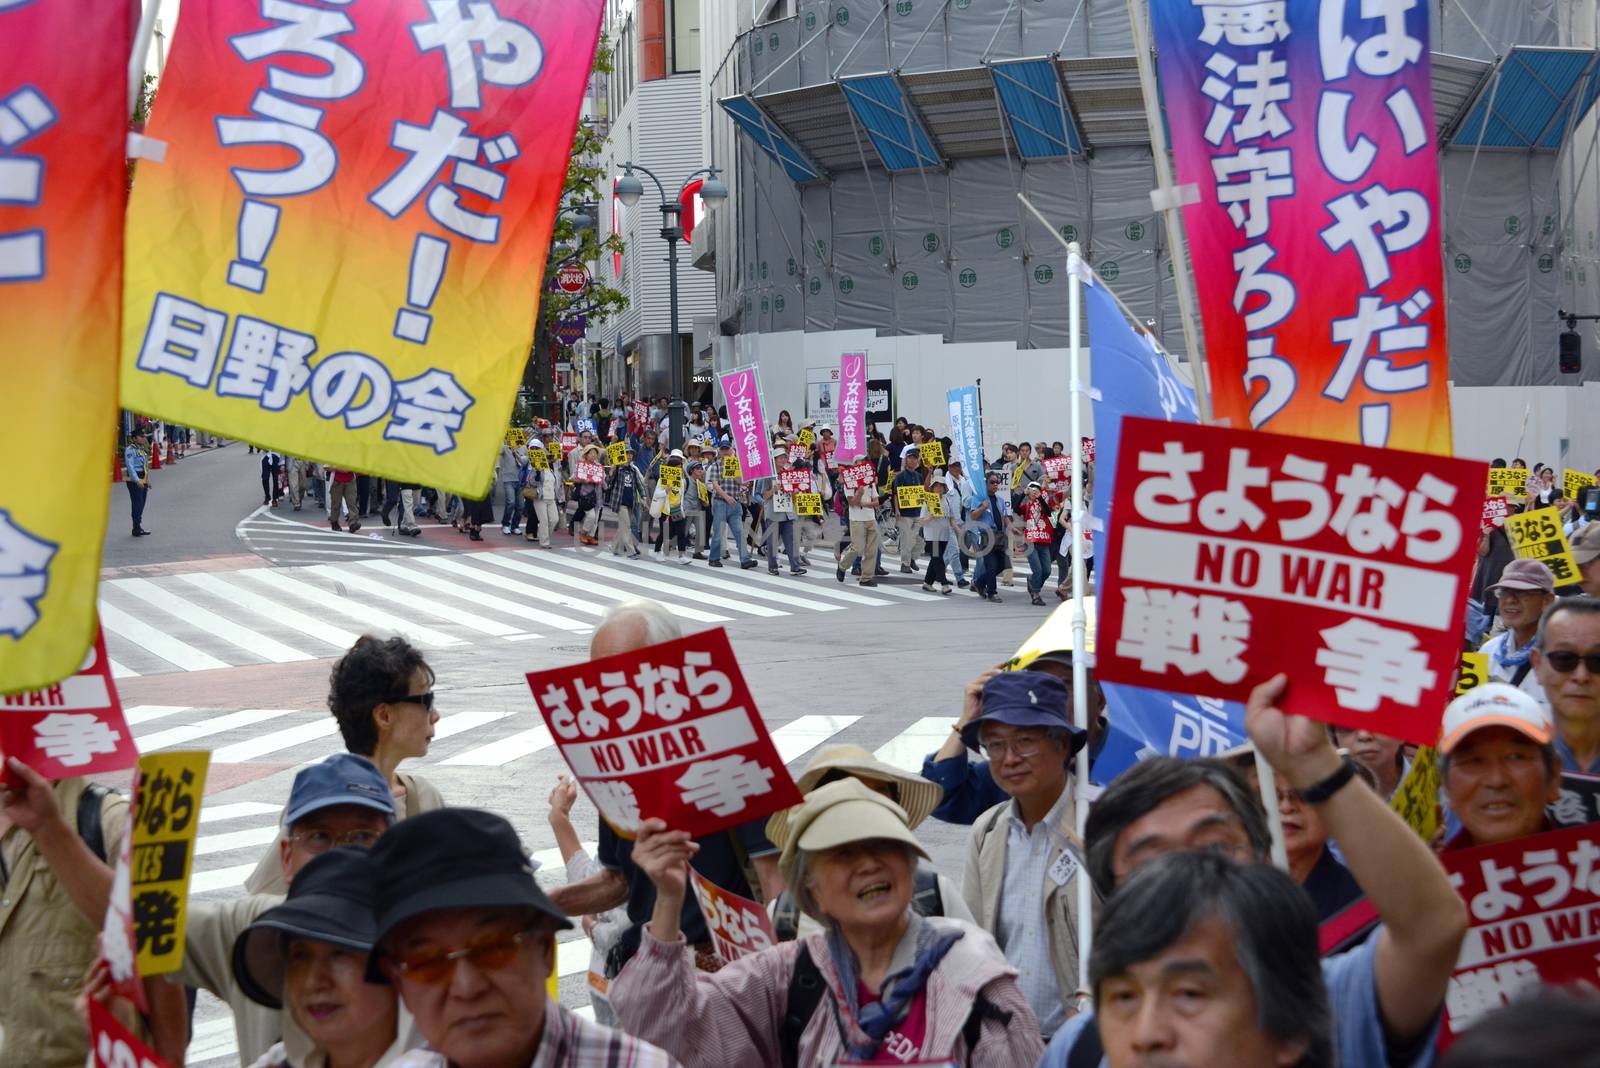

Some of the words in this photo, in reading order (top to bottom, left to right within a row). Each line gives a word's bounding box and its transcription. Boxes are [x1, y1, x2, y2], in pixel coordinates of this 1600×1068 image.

[560, 273, 584, 284] 消火栓
[137, 292, 475, 455] 日野の会
[735, 397, 762, 468] 女性会議
[842, 379, 861, 450] 女性会議
[1133, 441, 1462, 564] さようなら
[1490, 471, 1528, 480] さようなら
[1195, 542, 1260, 589] NO
[1282, 554, 1385, 610] WAR
[541, 651, 733, 740] さようなら
[591, 743, 625, 774] NO
[628, 725, 706, 769] WAR
[1451, 840, 1600, 921] ような
[1480, 921, 1533, 958] NO
[1544, 905, 1600, 943] WA
